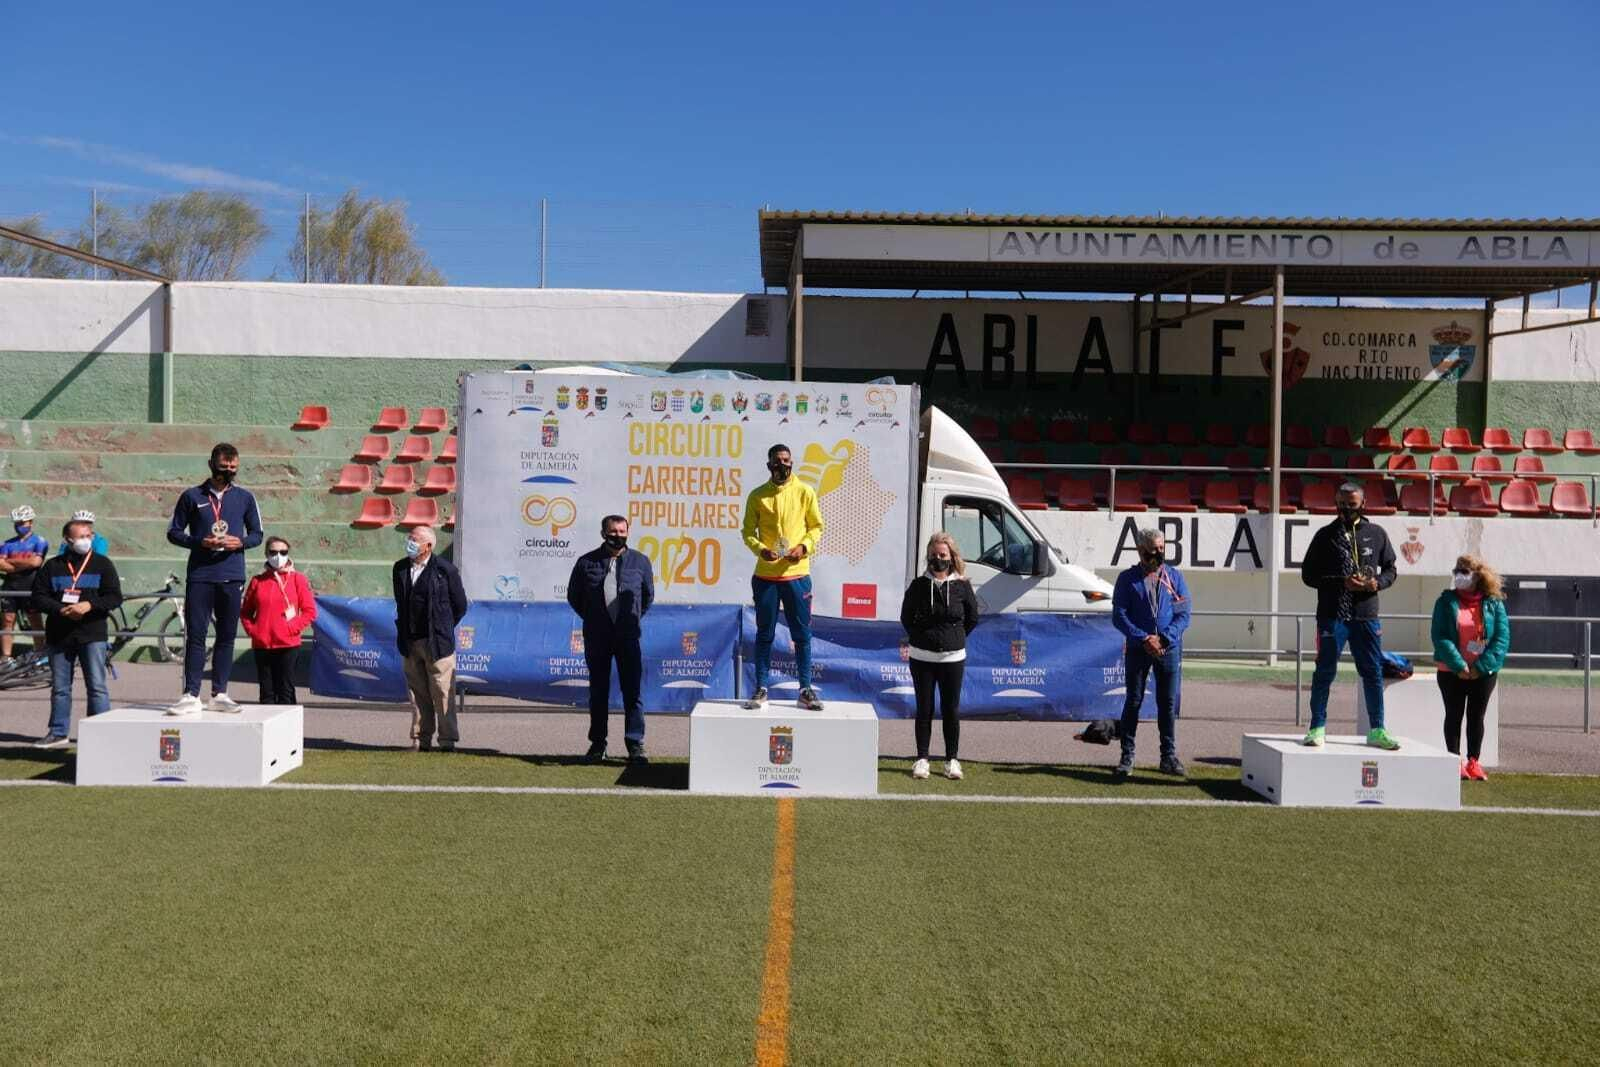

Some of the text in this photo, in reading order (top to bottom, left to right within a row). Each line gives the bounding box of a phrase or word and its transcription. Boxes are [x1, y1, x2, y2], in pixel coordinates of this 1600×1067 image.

[997, 231, 1573, 261] AYUNTAMIENTO de ABLA
[918, 312, 1120, 395] ABLA
[1358, 349, 1388, 364] RIO
[1321, 365, 1421, 381] NACIMIENTO
[628, 421, 743, 458] CIRCUITO
[520, 450, 580, 461] DIPUTACIÓN
[521, 460, 578, 471] DE ALMERÍA
[627, 465, 742, 496] CARRERAS
[628, 500, 740, 529] POPULARES
[1110, 516, 1263, 568] ABLA
[637, 532, 721, 591] 2020
[456, 653, 491, 664] TACIÓN
[549, 657, 587, 667] DIPUTAC
[662, 658, 713, 668] DIPUTACIÓN
[456, 663, 489, 672] LMERÍA
[550, 667, 562, 675] DE
[663, 668, 711, 677] DE ALMERÍA
[992, 667, 1047, 676] DIPUTACIÓN
[993, 676, 1045, 685] DE ALMERÍA
